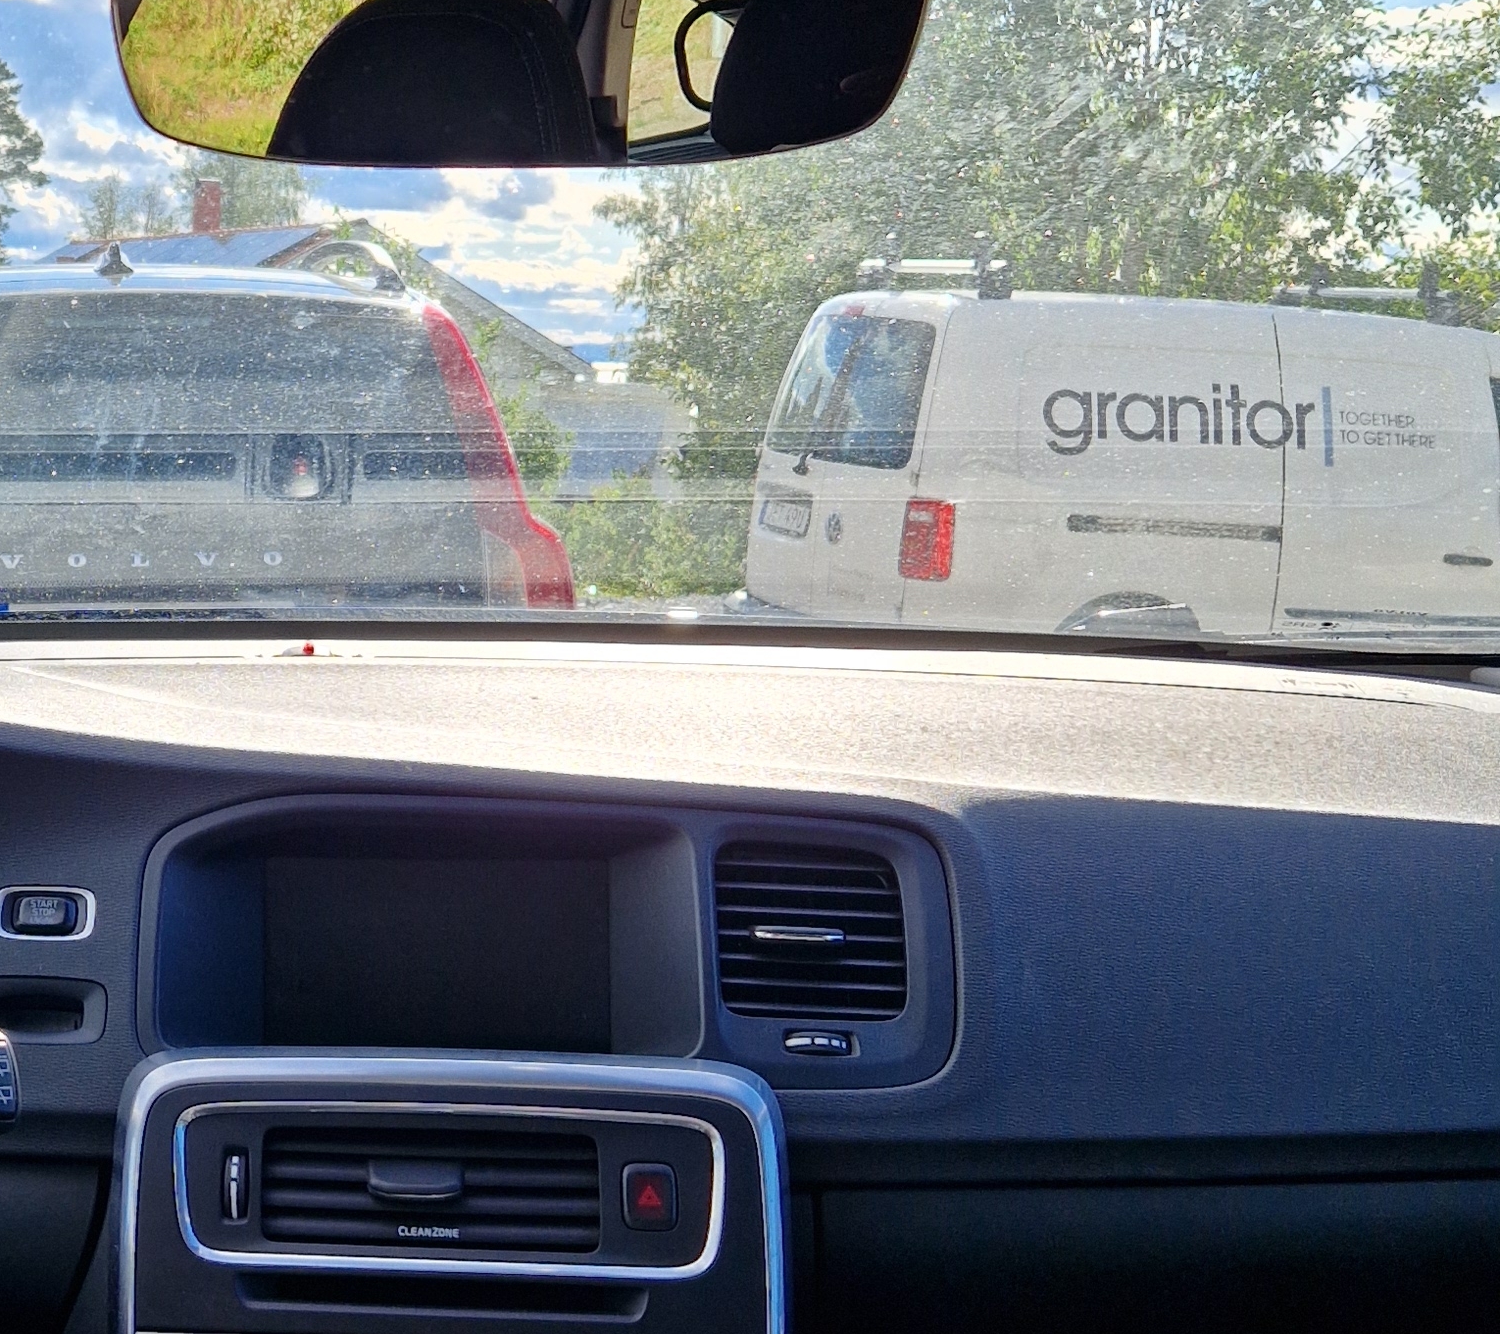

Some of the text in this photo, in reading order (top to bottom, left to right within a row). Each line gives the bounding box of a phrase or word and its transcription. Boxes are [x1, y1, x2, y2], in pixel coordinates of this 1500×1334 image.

[1042, 383, 1315, 456] granitor
[1339, 411, 1415, 429] TOGETHER
[1340, 430, 1437, 450] TO GET THERE
[0, 551, 283, 569] VOLVO
[30, 899, 58, 908] START
[31, 908, 56, 917] STOP
[397, 1225, 460, 1239] CLEANZONE
